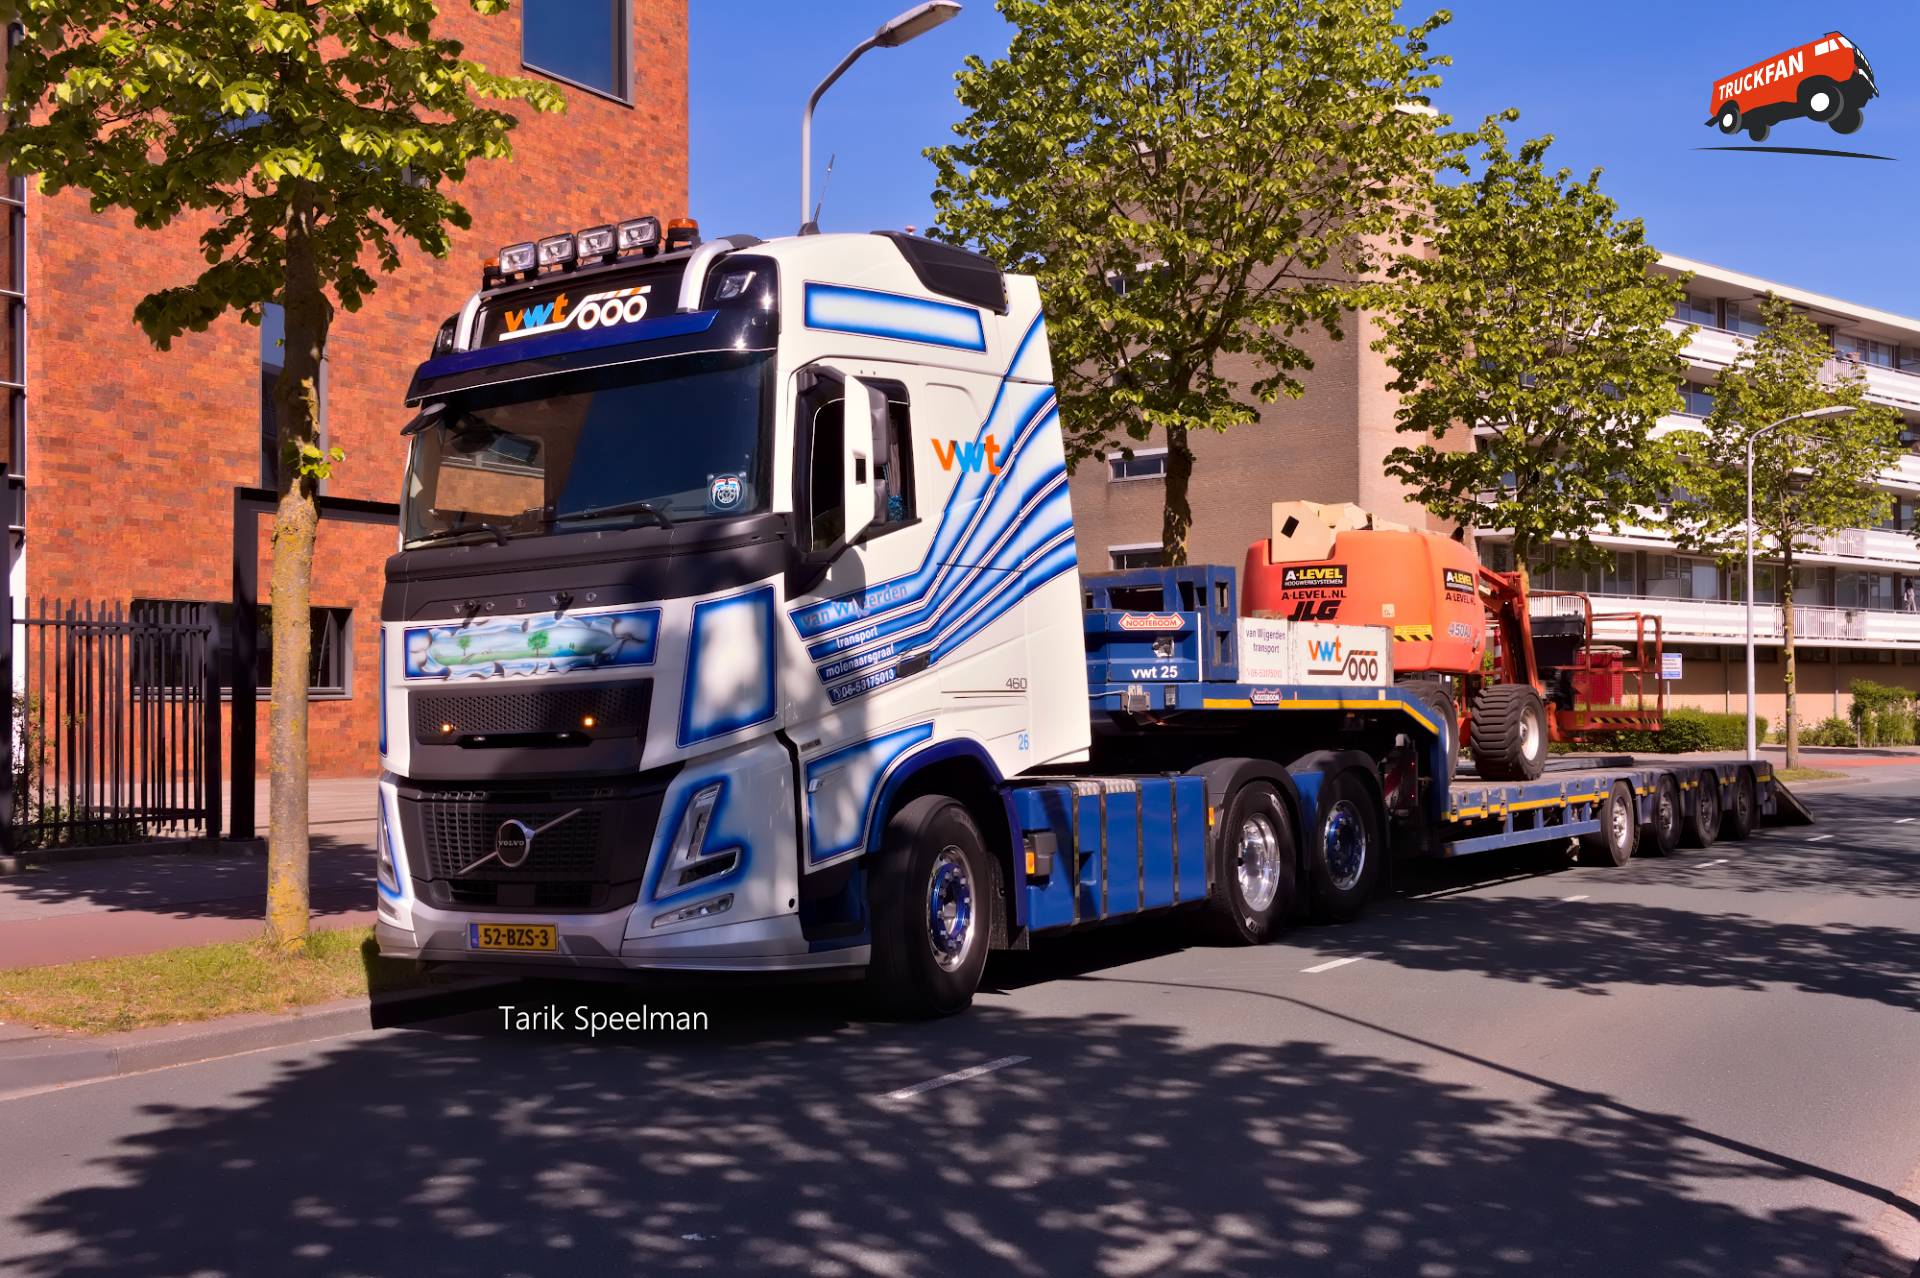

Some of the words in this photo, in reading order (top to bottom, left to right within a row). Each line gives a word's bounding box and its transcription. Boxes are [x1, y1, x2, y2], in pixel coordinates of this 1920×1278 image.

[504, 292, 569, 333] vwt
[930, 433, 1001, 476] vwt
[802, 610, 830, 628] van
[1287, 600, 1341, 621] JLG
[1126, 619, 1177, 627] NOOTEBOOM
[836, 625, 879, 649] transport
[1246, 629, 1257, 638] van
[1253, 643, 1280, 655] transport
[1308, 636, 1342, 663] vwt
[825, 642, 895, 678] molenaarsgraaf
[1131, 666, 1158, 679] vwt
[1160, 665, 1178, 679] 25
[841, 669, 895, 698] 06-53175013
[1005, 677, 1028, 690] 460
[1018, 733, 1029, 751] 26
[483, 928, 550, 947] 52-BZS-3
